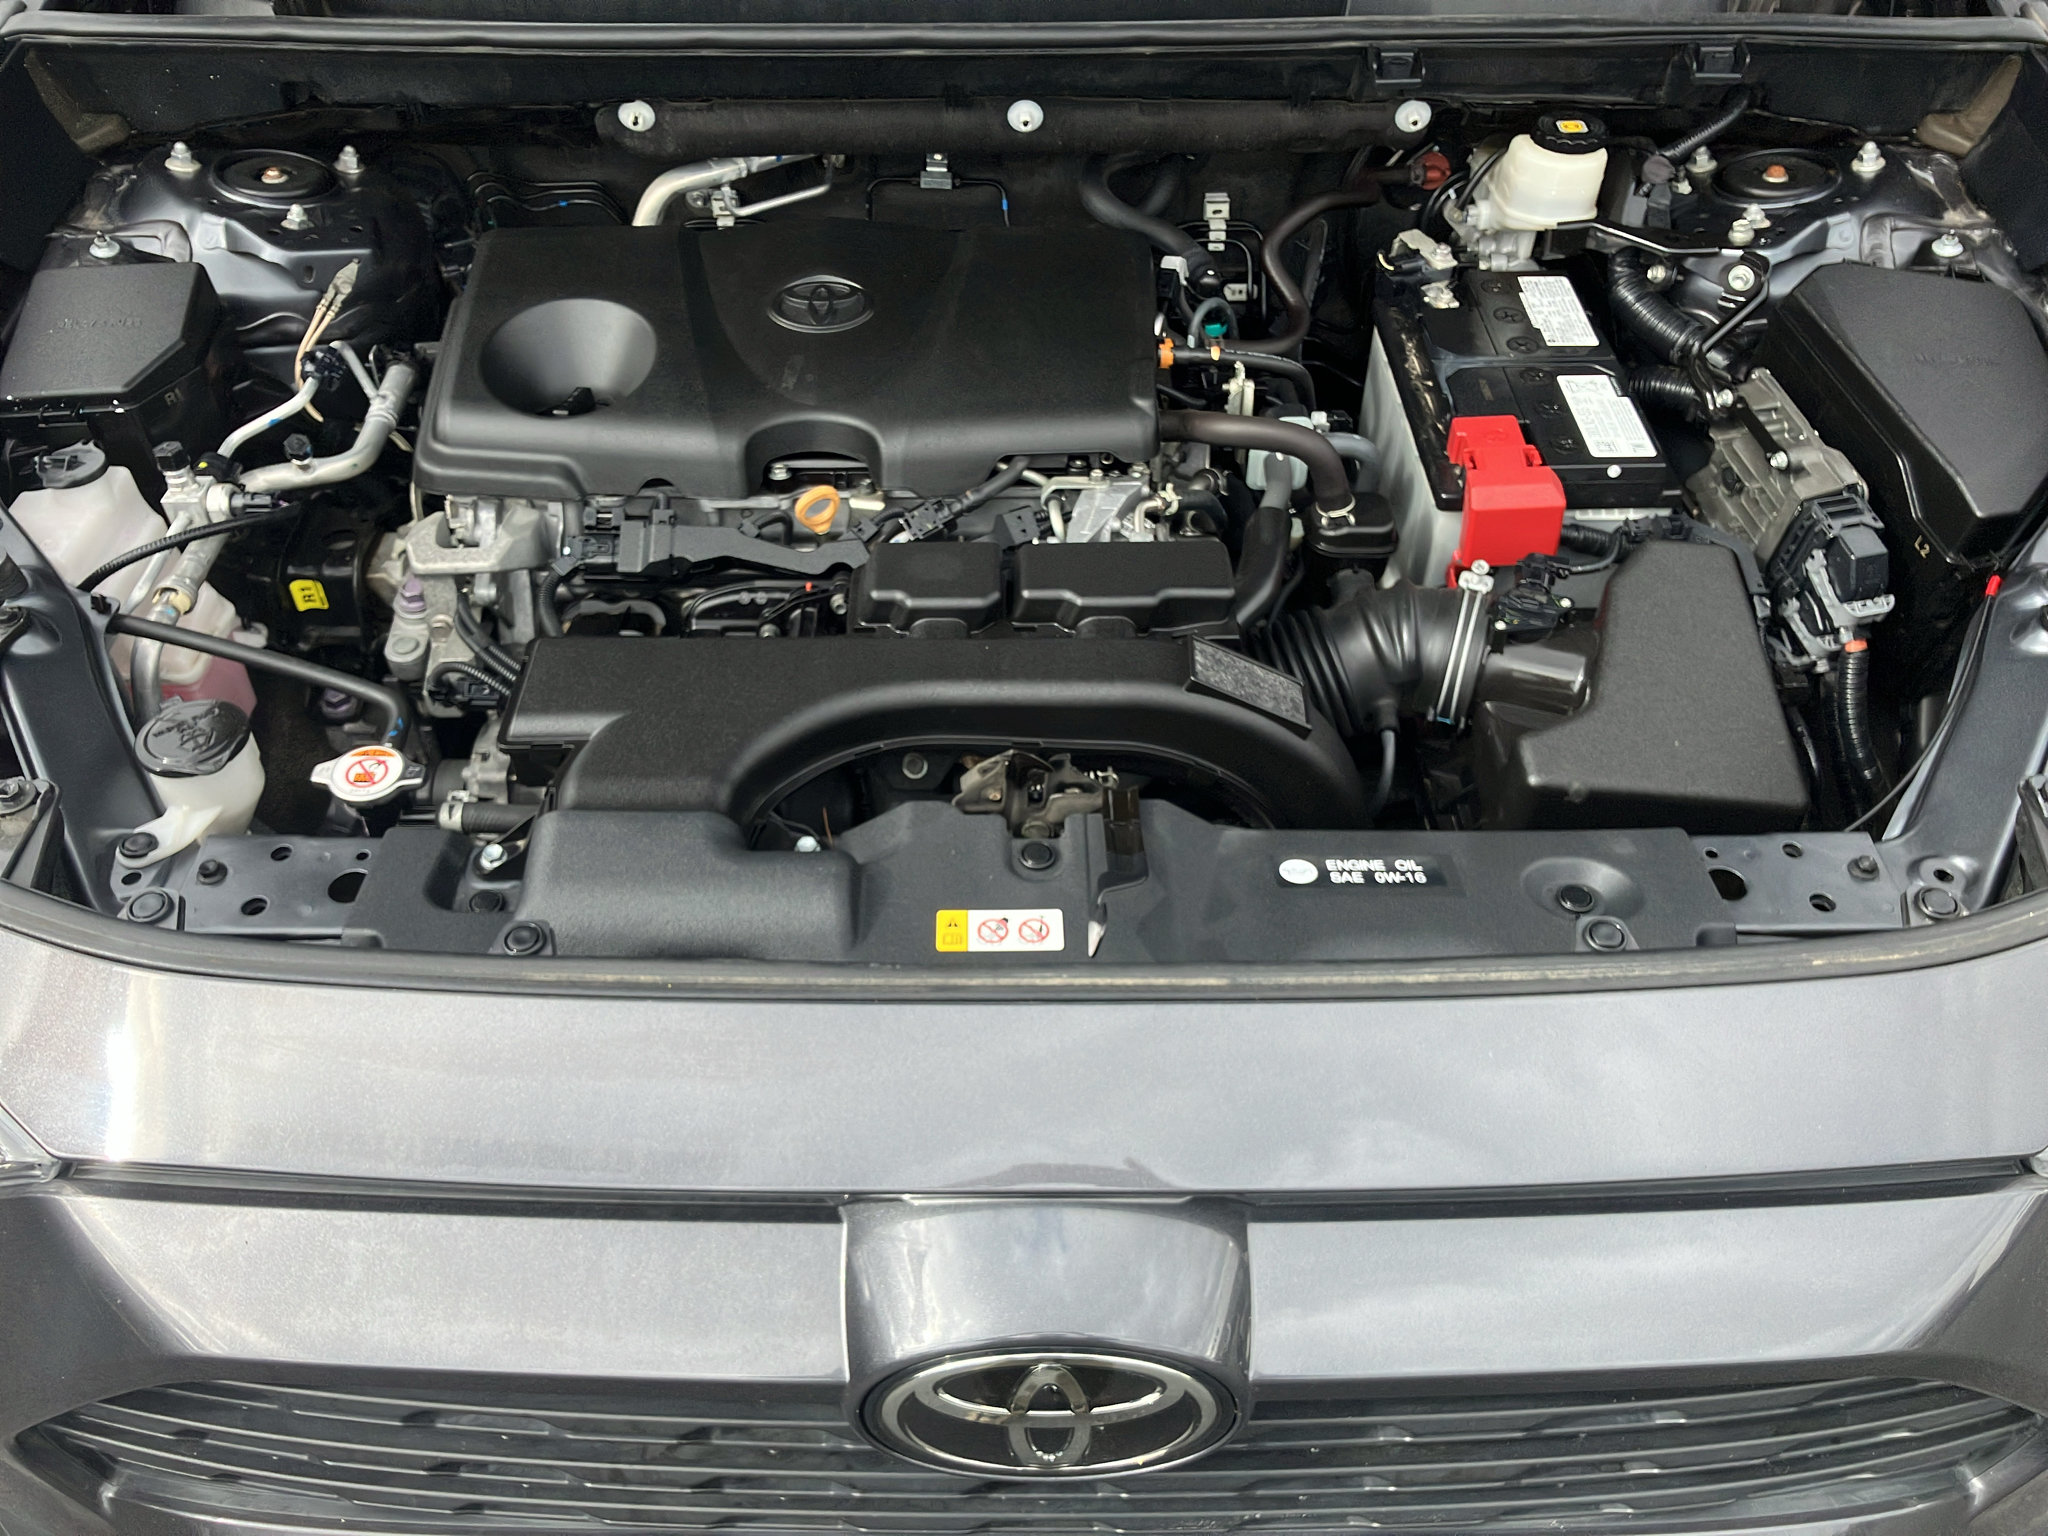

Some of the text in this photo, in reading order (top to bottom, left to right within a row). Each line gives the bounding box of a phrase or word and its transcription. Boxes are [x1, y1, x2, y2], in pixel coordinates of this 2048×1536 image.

[1914, 534, 1931, 559] L2
[1324, 858, 1386, 871] ENGINE
[1394, 858, 1424, 871] OIL
[1330, 871, 1427, 884] SAE 0W-16
